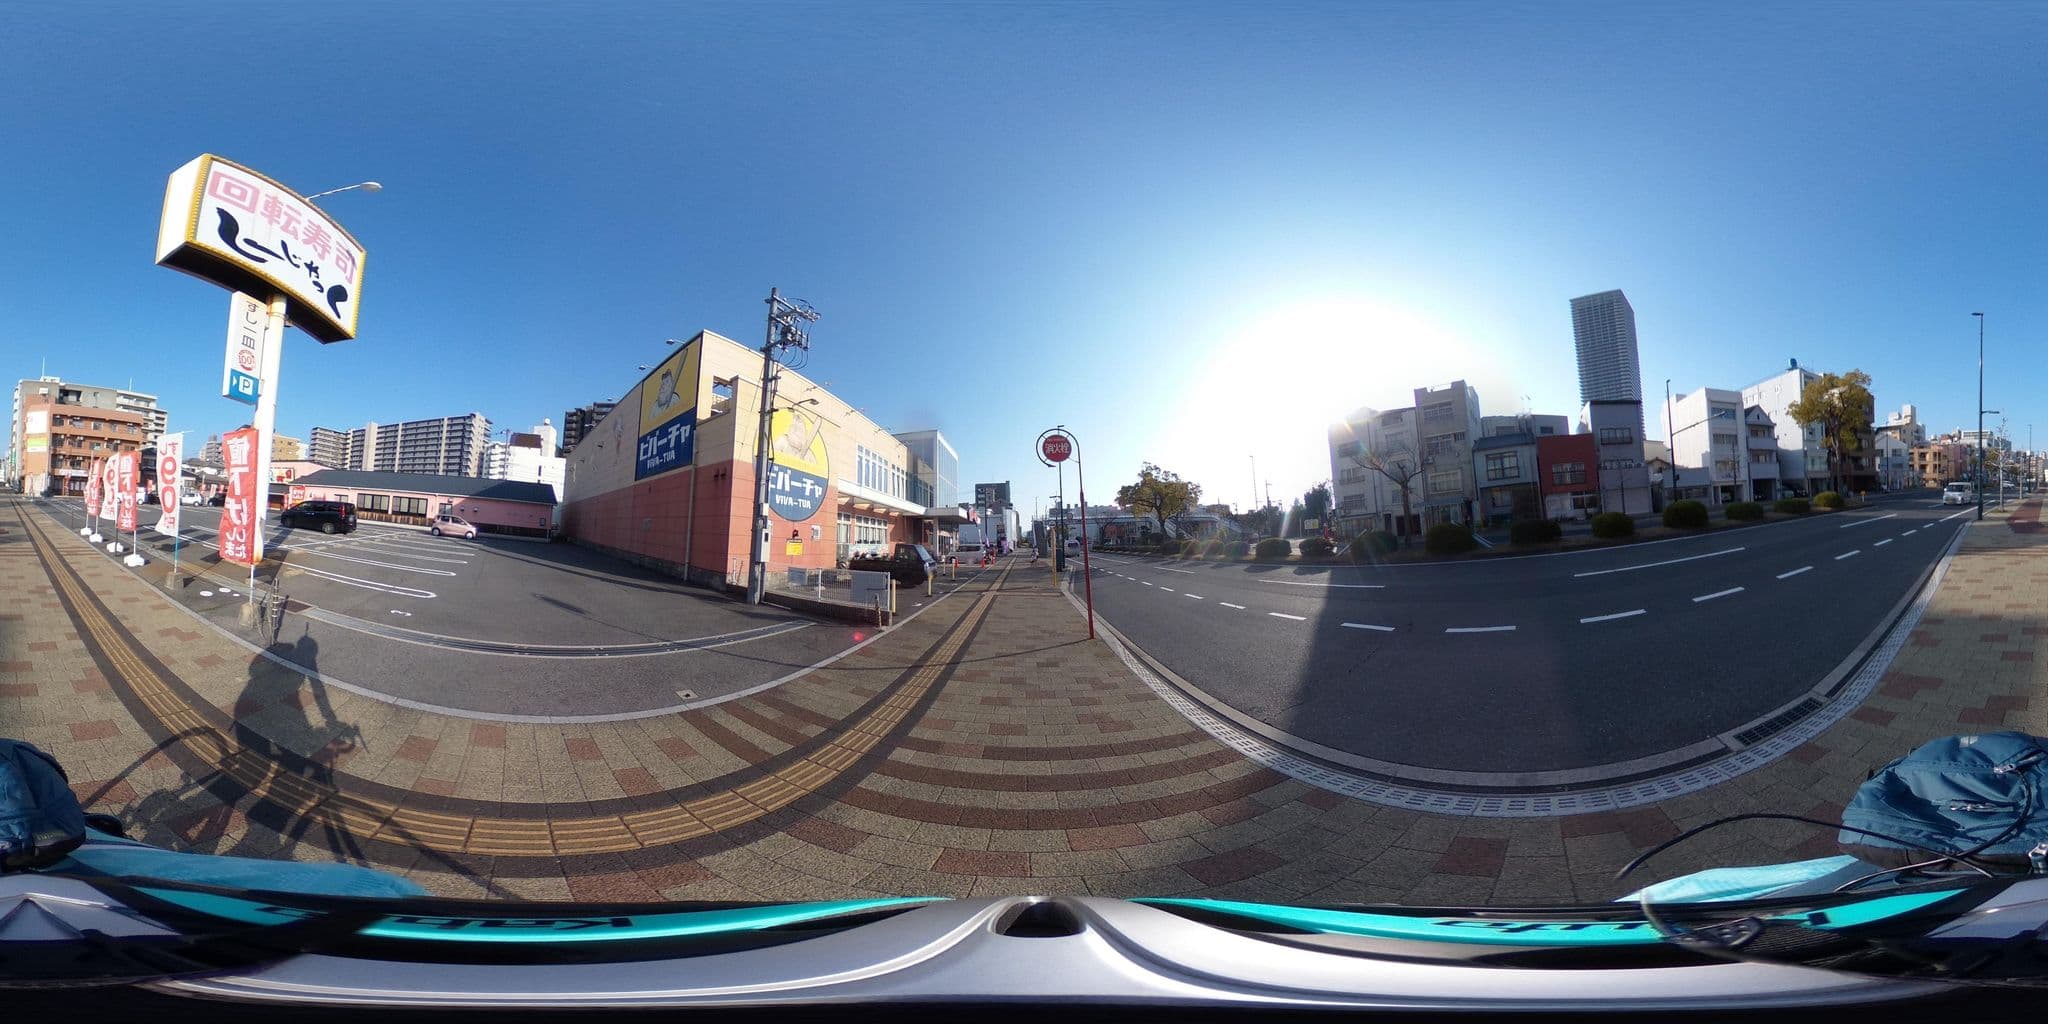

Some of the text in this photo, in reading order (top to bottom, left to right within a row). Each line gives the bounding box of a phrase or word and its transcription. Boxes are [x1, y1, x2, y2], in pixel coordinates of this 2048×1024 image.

[208, 170, 357, 284] 回転寿司
[242, 301, 258, 350] すし一皿
[242, 378, 251, 391] P
[639, 423, 690, 461] ビバーチャ
[1045, 442, 1070, 454] 消火栓
[647, 449, 676, 469] VIVA-TUA
[775, 494, 812, 509] VIVA-TUA
